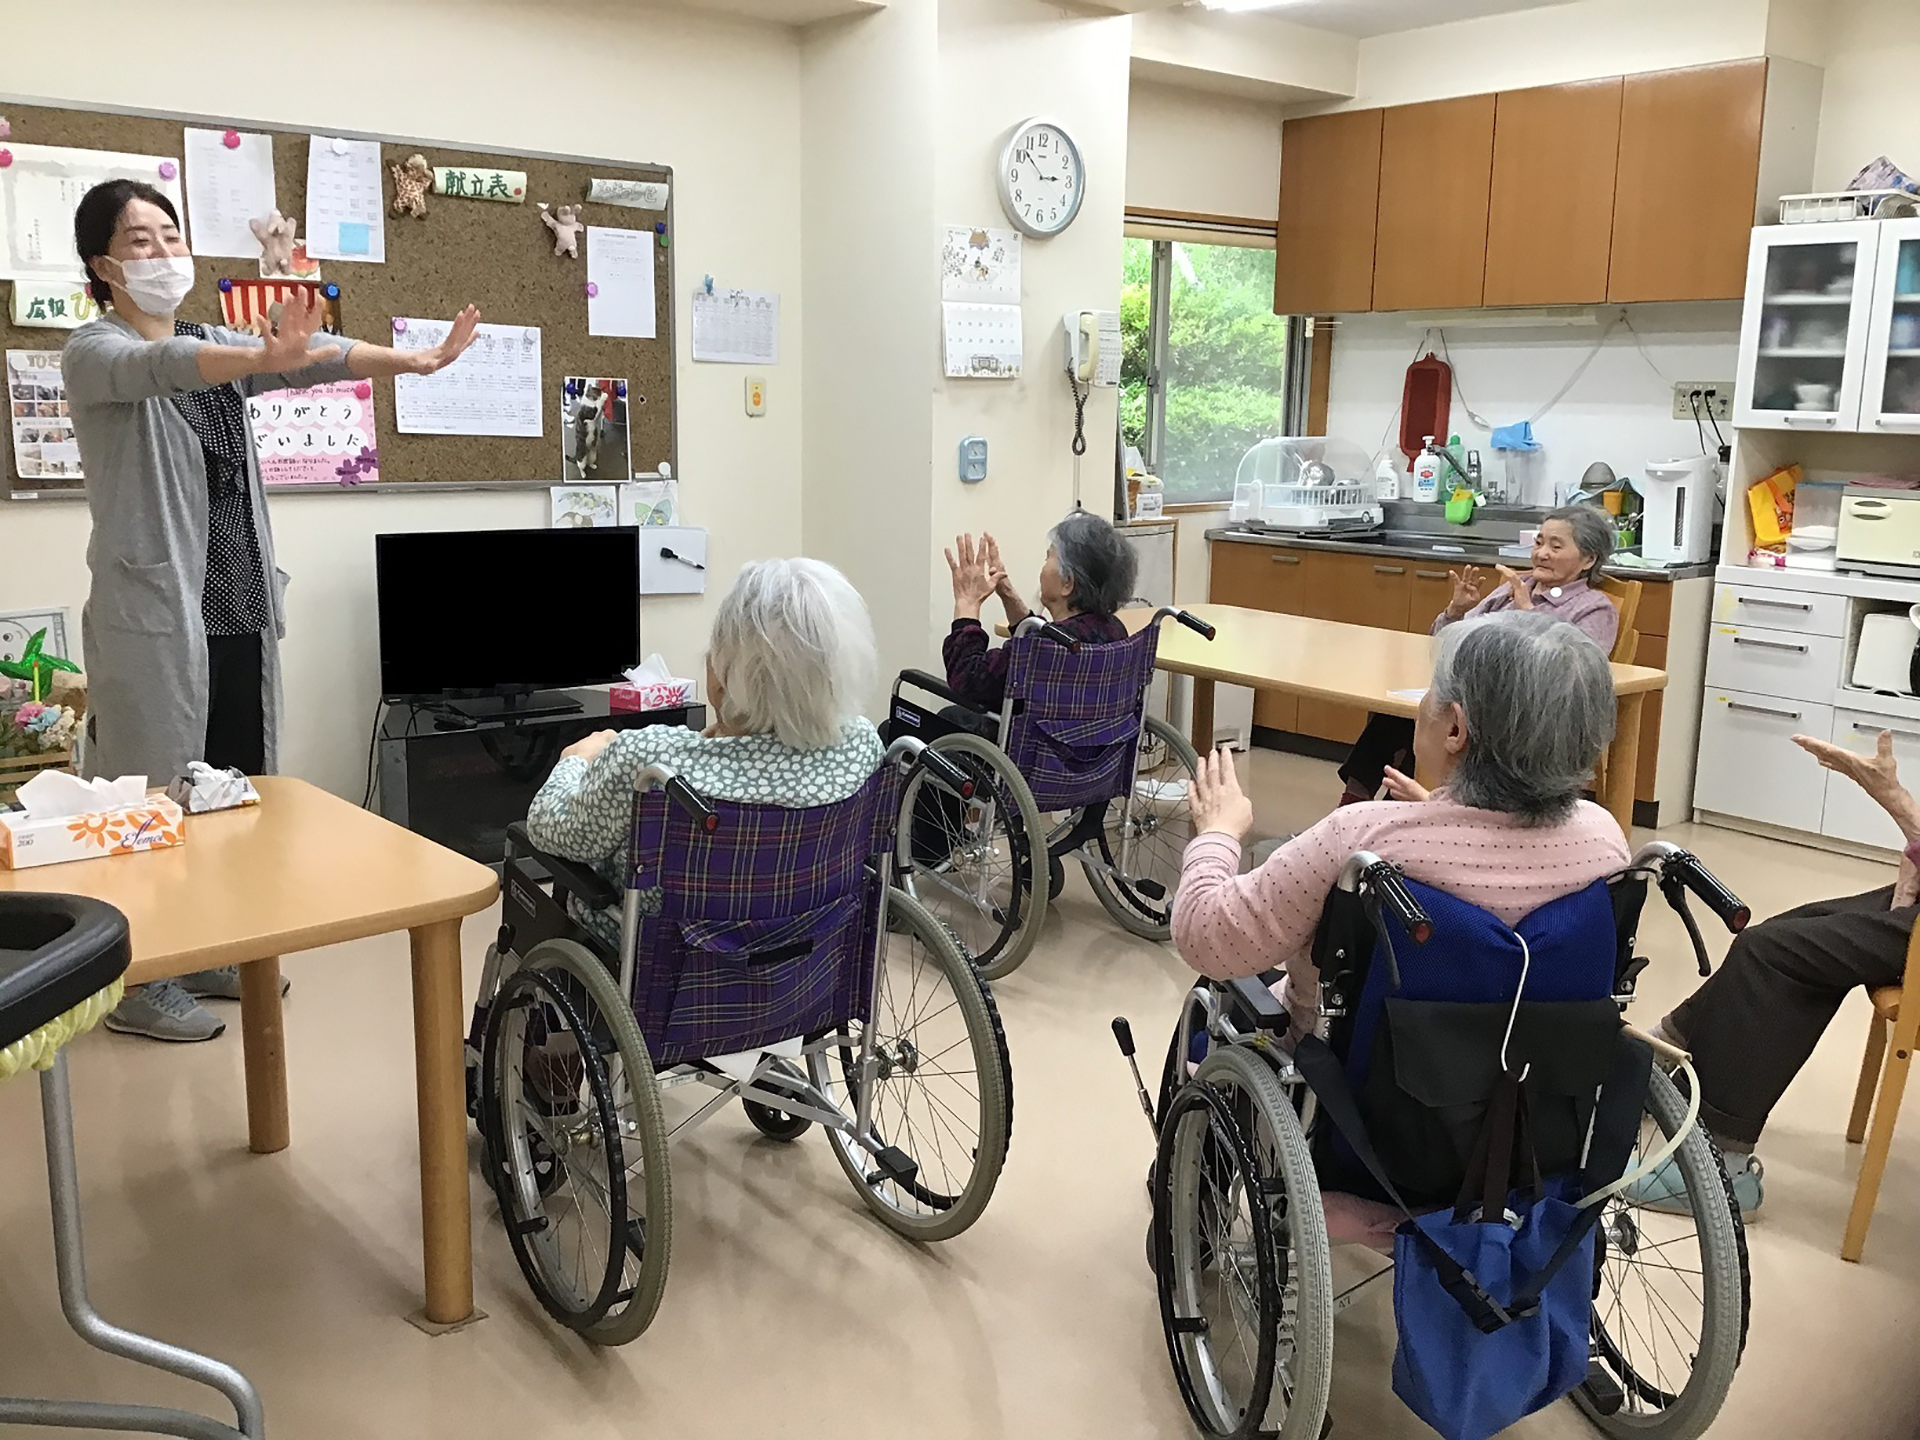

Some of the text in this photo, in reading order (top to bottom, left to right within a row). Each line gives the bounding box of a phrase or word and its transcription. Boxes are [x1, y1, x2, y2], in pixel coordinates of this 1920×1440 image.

[1026, 135, 1034, 150] 11
[1038, 133, 1048, 147] 12
[1054, 140, 1059, 154] 1
[1015, 149, 1026, 164] 10
[1061, 155, 1069, 169] 2
[1010, 168, 1019, 183] 9
[1064, 175, 1073, 189] 3
[445, 169, 514, 198] 献立表
[1015, 188, 1022, 202] 8
[1060, 194, 1066, 207] 4
[1024, 204, 1031, 217] 7
[1036, 209, 1043, 223] 6
[1050, 207, 1057, 220] 5
[26, 292, 103, 320] 広報ひ
[311, 386, 323, 397] you
[325, 386, 334, 394] so
